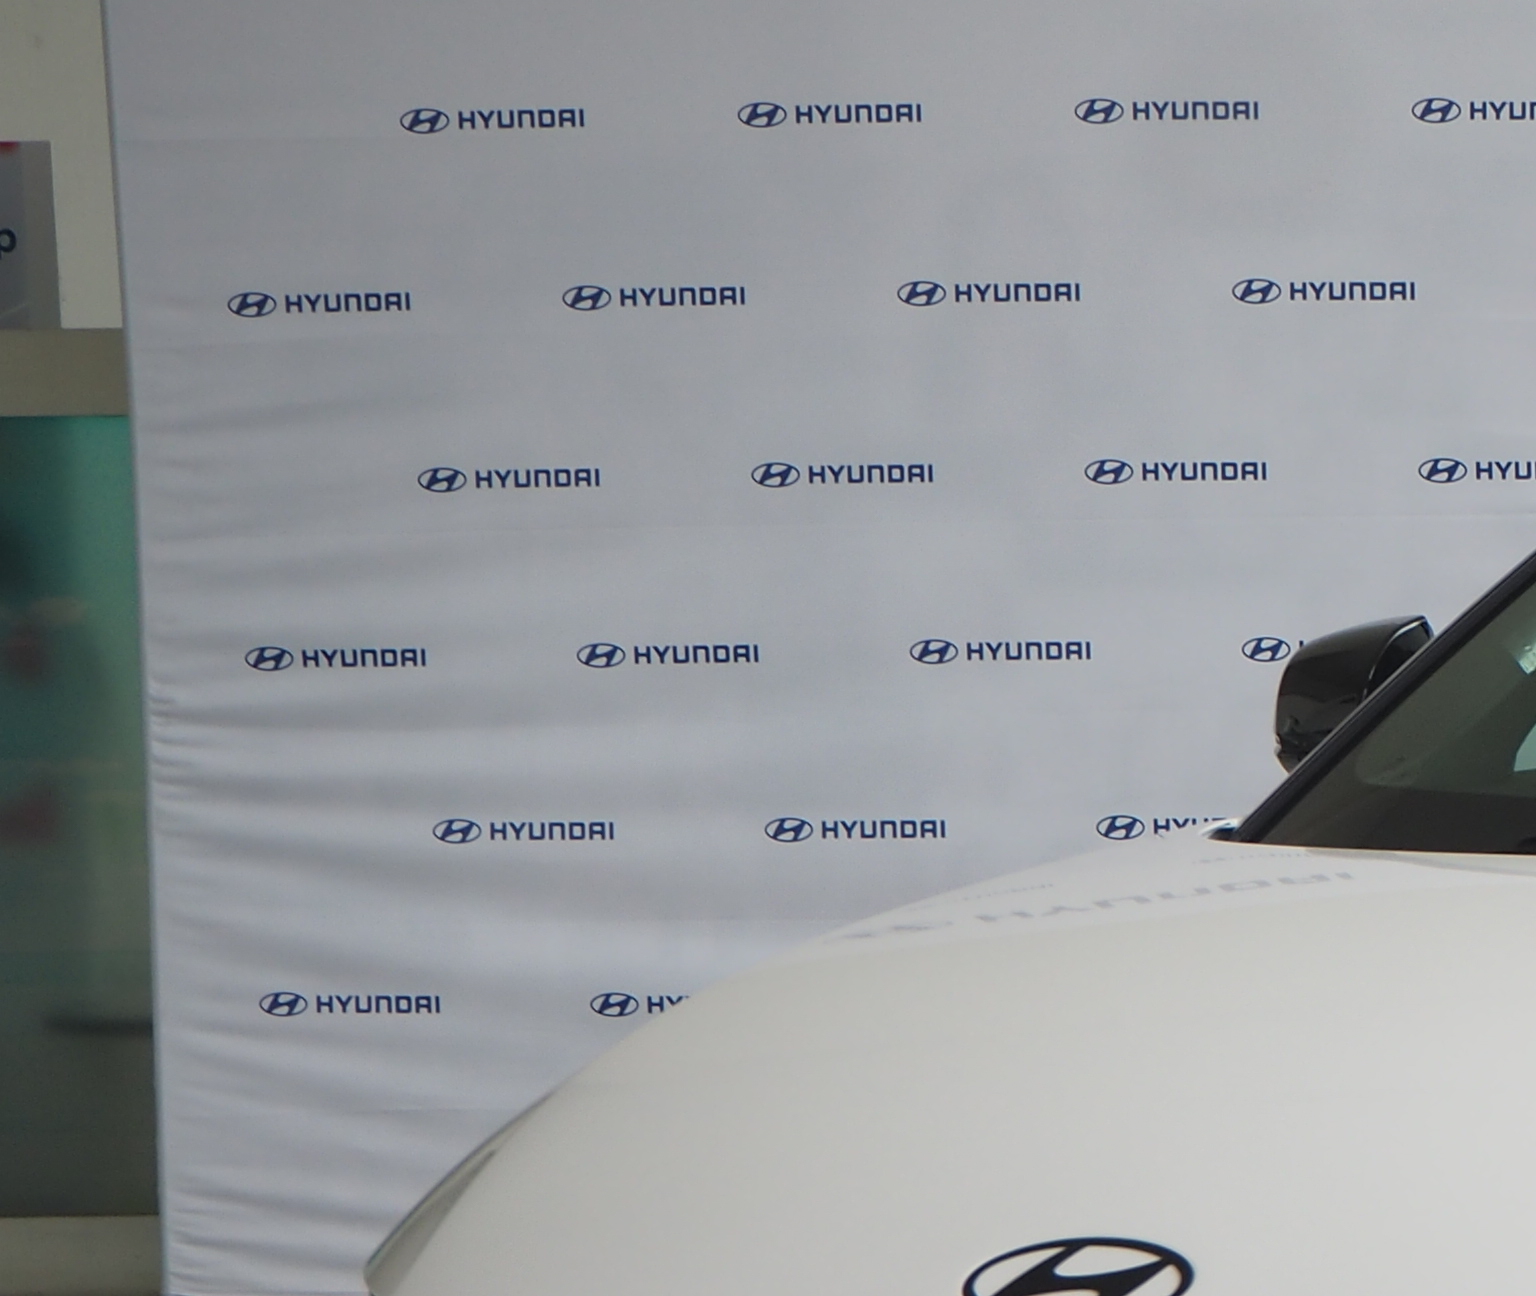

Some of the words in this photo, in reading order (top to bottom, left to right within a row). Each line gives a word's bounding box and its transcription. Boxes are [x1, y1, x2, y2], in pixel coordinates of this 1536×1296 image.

[457, 107, 586, 130] HYUNDAI
[794, 102, 922, 124] HYUNDAI
[1132, 100, 1259, 121] HYUNDAI
[283, 290, 412, 313] HYUNDAI
[618, 285, 746, 307] HYUNDAI
[954, 282, 1081, 303] HYUNDAI
[1289, 281, 1416, 301] HYUNDAI
[474, 467, 601, 489] HYUNDAI
[807, 463, 934, 484] HYUNDAI
[1141, 461, 1267, 481] HYUNDAI
[300, 647, 427, 668] HYUNDAI
[633, 643, 760, 665] HYUNDAI
[966, 640, 1092, 661] HYUNDAI
[489, 821, 615, 841] HYUNDAI
[821, 819, 946, 839] HYUNDAI
[315, 994, 441, 1014] HYUNDAI
